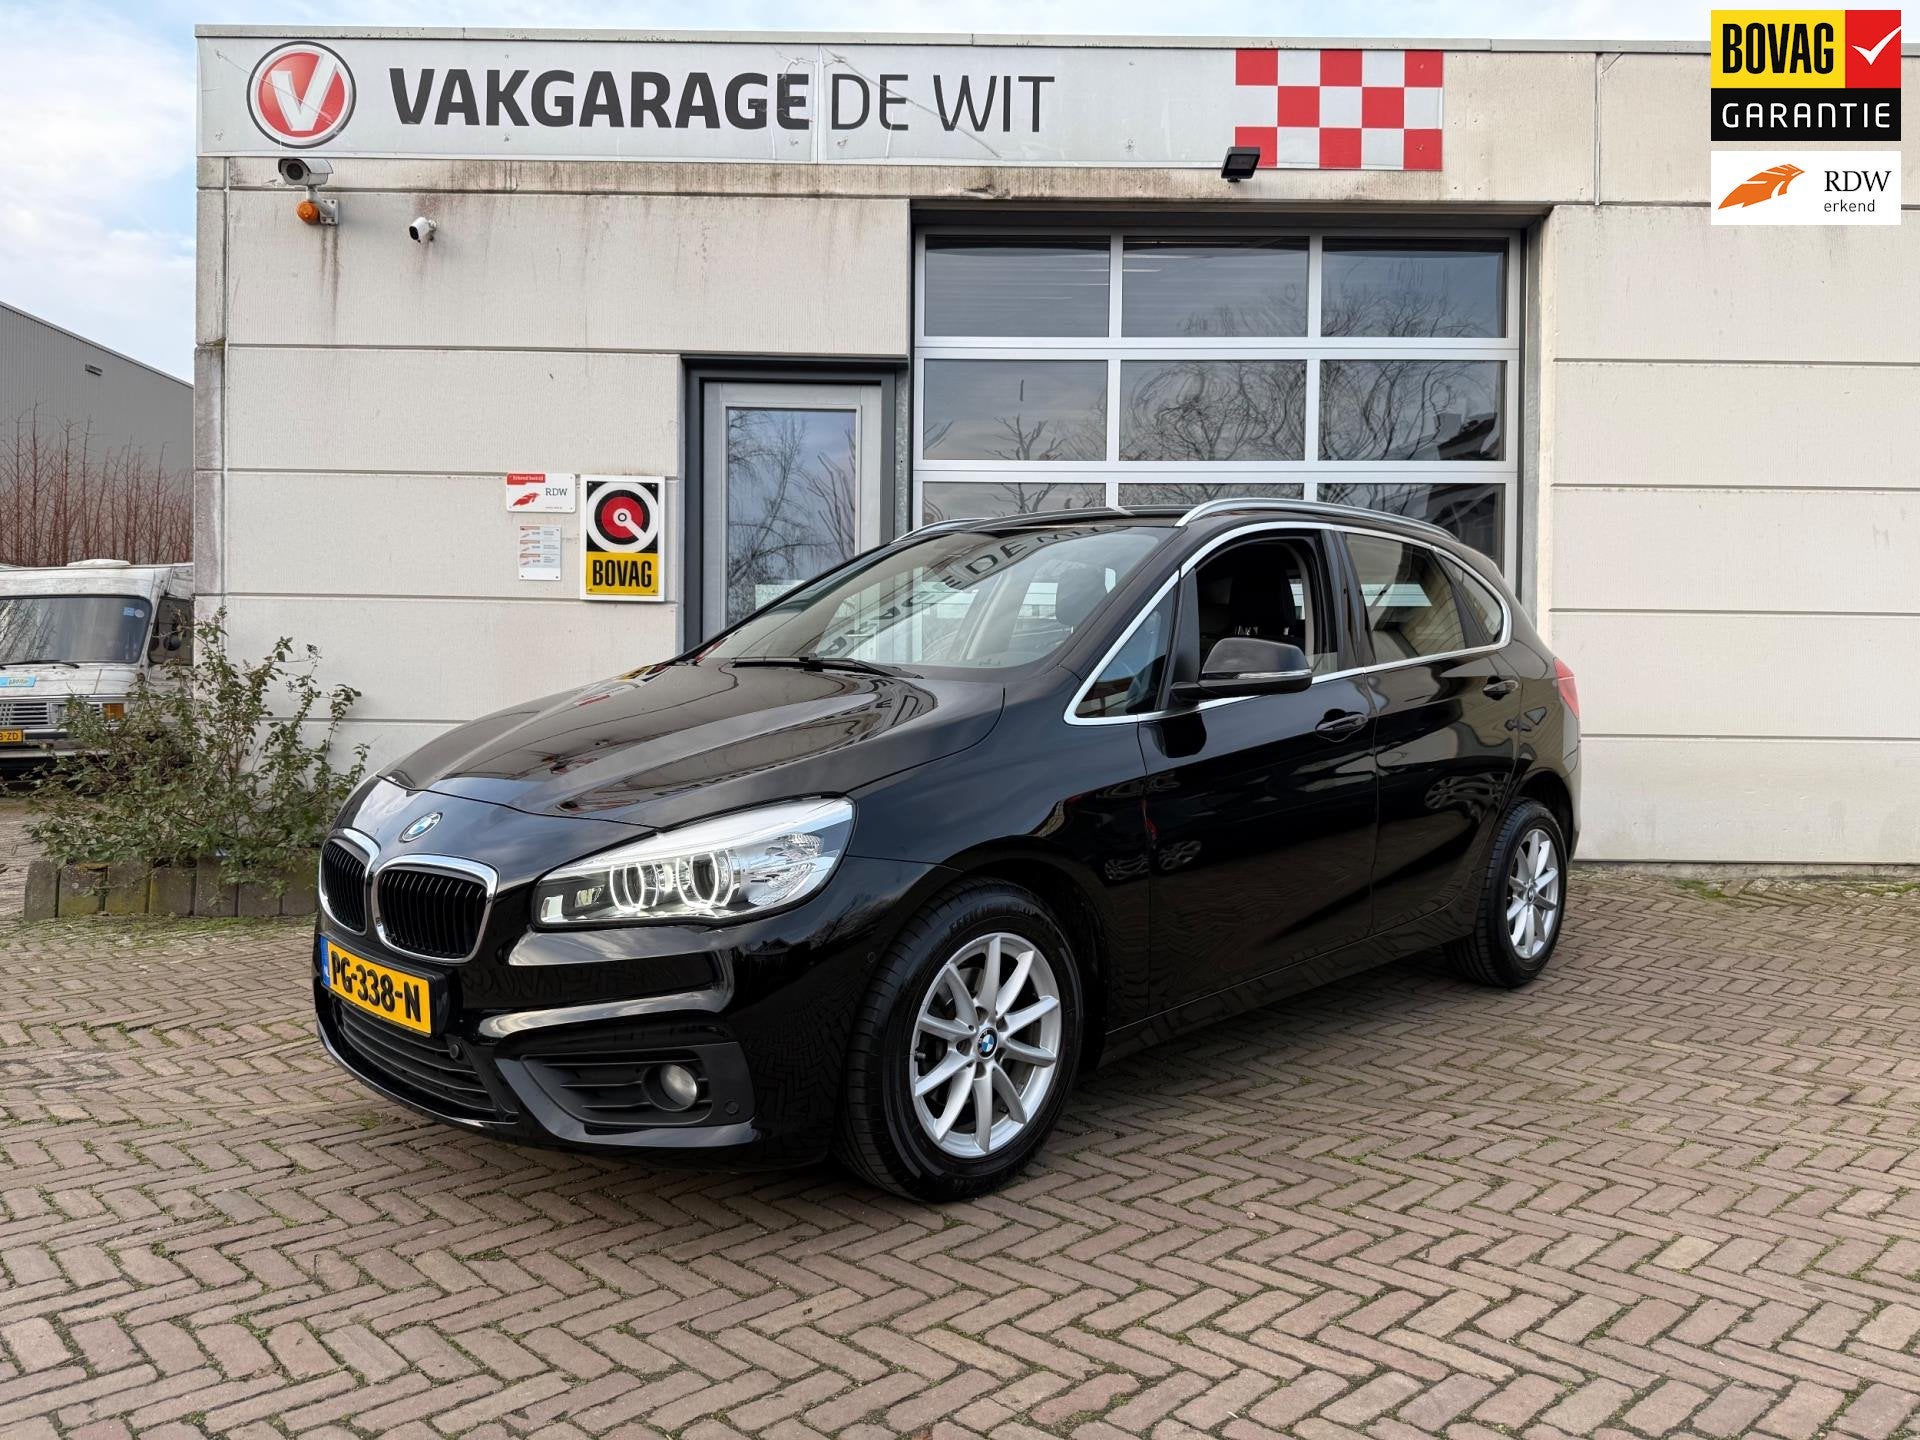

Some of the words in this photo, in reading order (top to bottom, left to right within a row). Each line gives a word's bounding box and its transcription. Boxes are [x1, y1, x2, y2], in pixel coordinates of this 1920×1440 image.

[389, 67, 810, 130] VAKGARAGE
[831, 73, 909, 131] DE
[933, 74, 1056, 133] WIT
[545, 487, 568, 497] RDW
[592, 559, 652, 588] BOVAG
[330, 951, 422, 1023] PG-338-N
